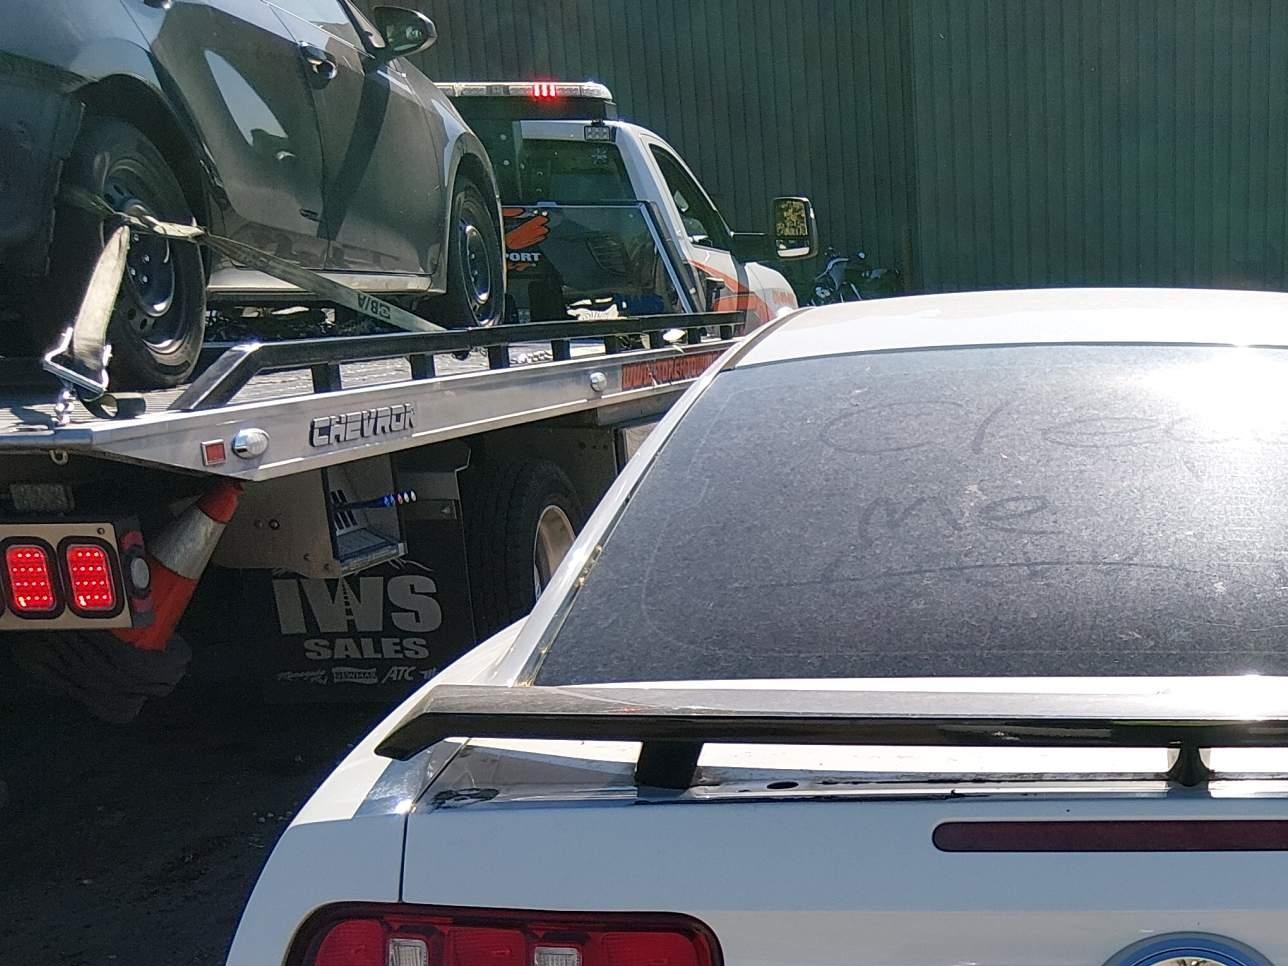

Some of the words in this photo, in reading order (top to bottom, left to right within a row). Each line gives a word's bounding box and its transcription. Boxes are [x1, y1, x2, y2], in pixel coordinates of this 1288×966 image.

[309, 403, 415, 447] CHEVRON
[272, 575, 442, 635] IWS
[303, 638, 430, 660] SALES
